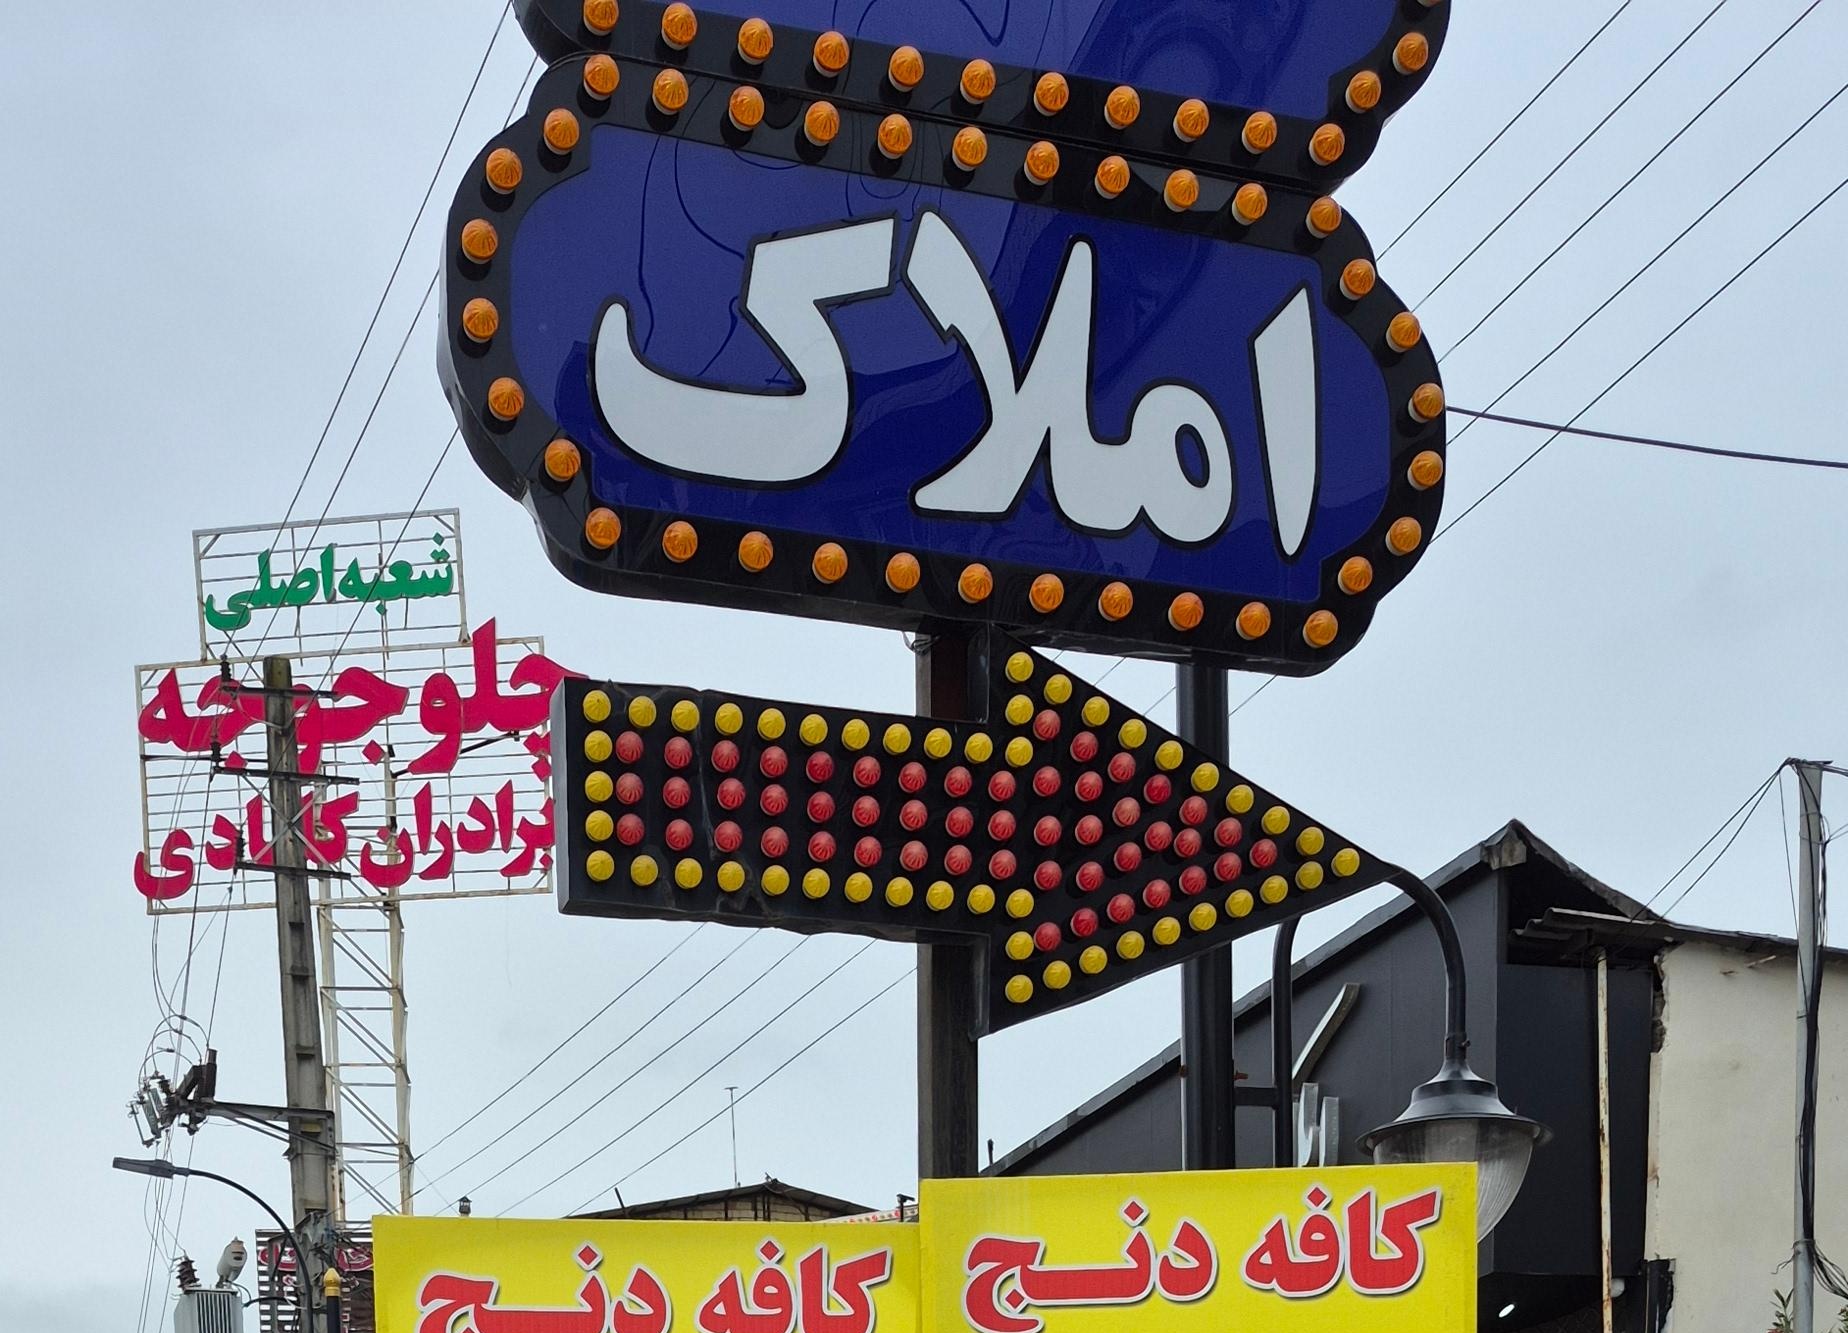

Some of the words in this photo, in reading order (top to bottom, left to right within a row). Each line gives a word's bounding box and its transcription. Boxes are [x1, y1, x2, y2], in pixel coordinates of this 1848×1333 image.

[590, 211, 1320, 559] املاک
[205, 544, 336, 630] اصلی
[338, 532, 454, 615] شعبه
[360, 781, 555, 888] برادران
[1244, 1188, 1438, 1296] کافه
